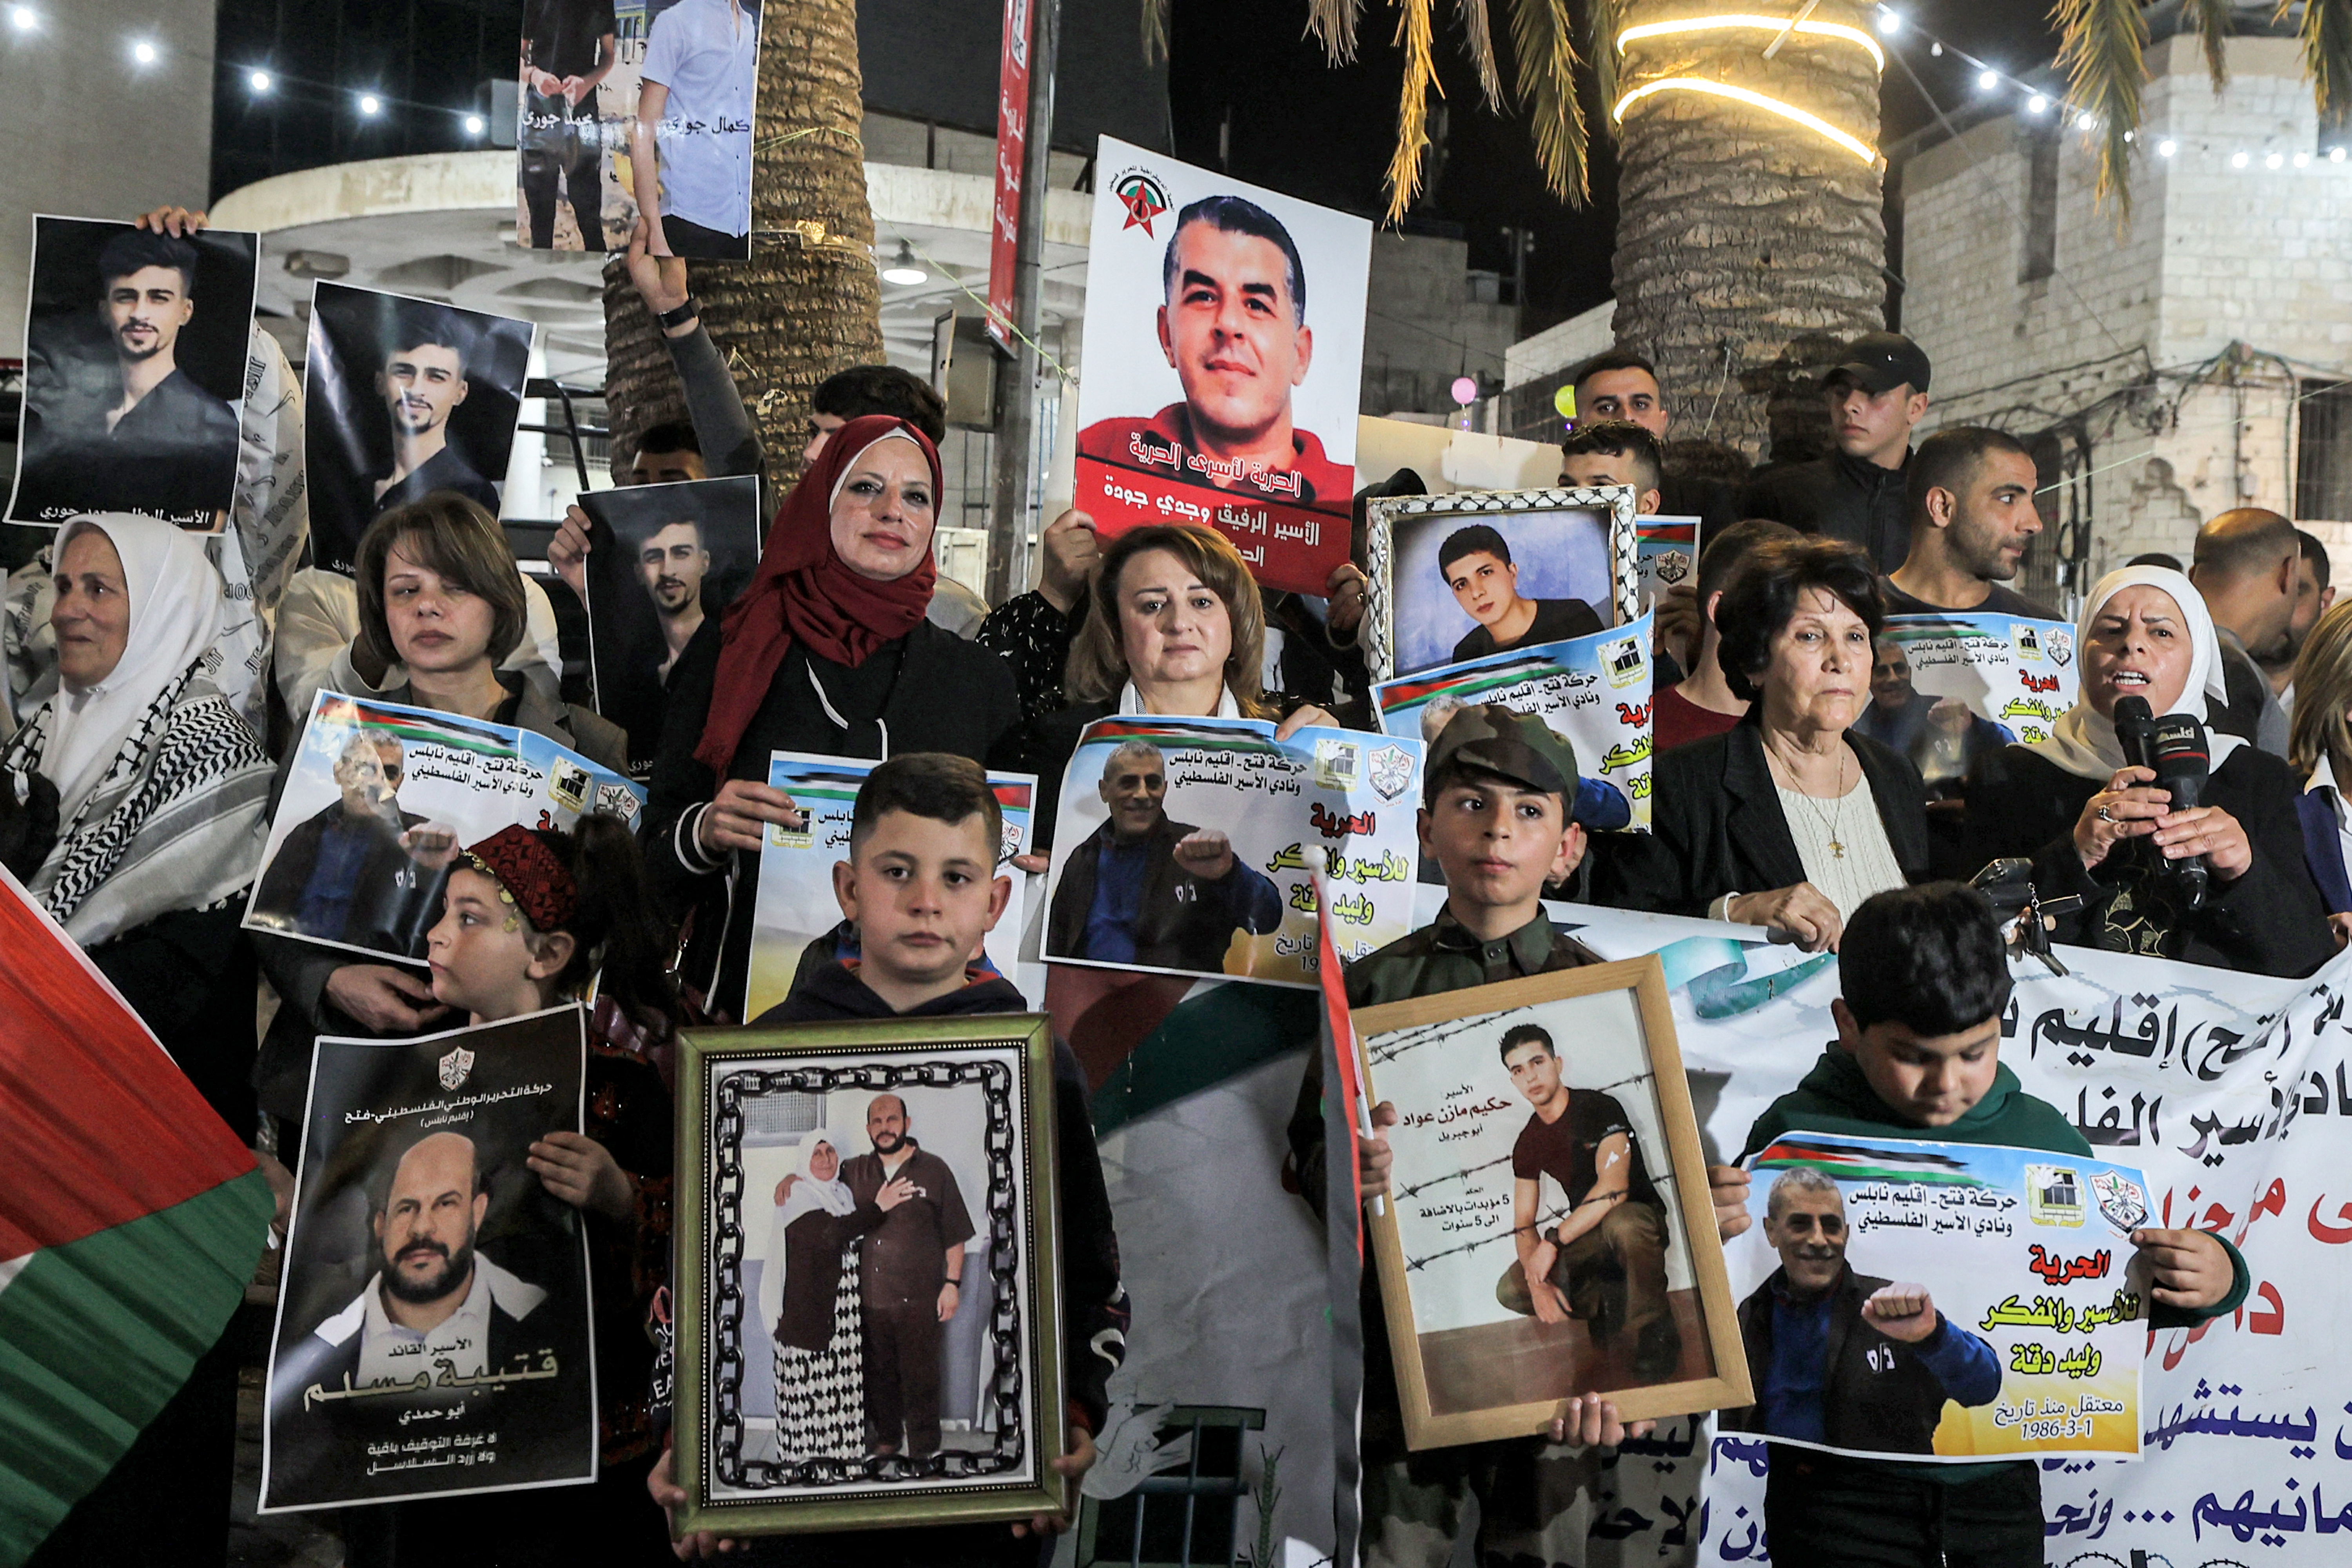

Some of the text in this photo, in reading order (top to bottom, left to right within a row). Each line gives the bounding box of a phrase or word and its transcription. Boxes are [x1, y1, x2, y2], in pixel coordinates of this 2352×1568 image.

[712, 116, 750, 134] كمال
[1129, 432, 1302, 499] الحرية لأسرى الحرية
[1103, 474, 1320, 546] الأسير الرفيق وجدي جودة
[1908, 639, 1934, 654] نابلس
[1982, 638, 2009, 651] حركة
[1916, 654, 1959, 670] الفلسطيني
[1987, 653, 2009, 664] ونادي
[1562, 673, 1599, 688] حركة
[2019, 668, 2060, 693] الحرية
[1573, 691, 1601, 710] ونادي
[408, 746, 444, 761] نابلس
[1169, 751, 1203, 767] نابلس
[412, 764, 471, 784] الفلسطيني
[506, 760, 544, 780] حركة
[1269, 755, 1308, 775] حركة
[471, 775, 503, 791] الأسير
[1174, 770, 1301, 797] ونادي الأسير الفلسطيني
[818, 809, 854, 826] ابلس
[1310, 802, 1376, 838] الحرية
[1346, 849, 1409, 884] للأسير
[1332, 893, 1374, 925] وليد
[1275, 933, 1313, 956] تاريخ
[1403, 1096, 1512, 1128] حكيم مازن عواد
[1502, 1194, 1510, 1205] 5
[1849, 1185, 1889, 1205] نابلس
[1969, 1186, 2018, 1212] حركة
[1442, 1220, 1473, 1232] سنوات
[1475, 1215, 1482, 1226] 5
[1858, 1210, 2013, 1238] ونادي الأسير الفلسطيني
[2028, 1243, 2111, 1286] الحرية
[1979, 1294, 2075, 1333] والمفكر
[2074, 1288, 2141, 1334] للأسير
[2010, 1342, 2102, 1379] وليد دقة
[303, 1347, 559, 1412] قتيبة مسلم
[398, 1407, 443, 1426] حمدي
[1994, 1394, 2124, 1426] معتقل منذ تاريخ
[2021, 1419, 2092, 1439] 1986-3-1
